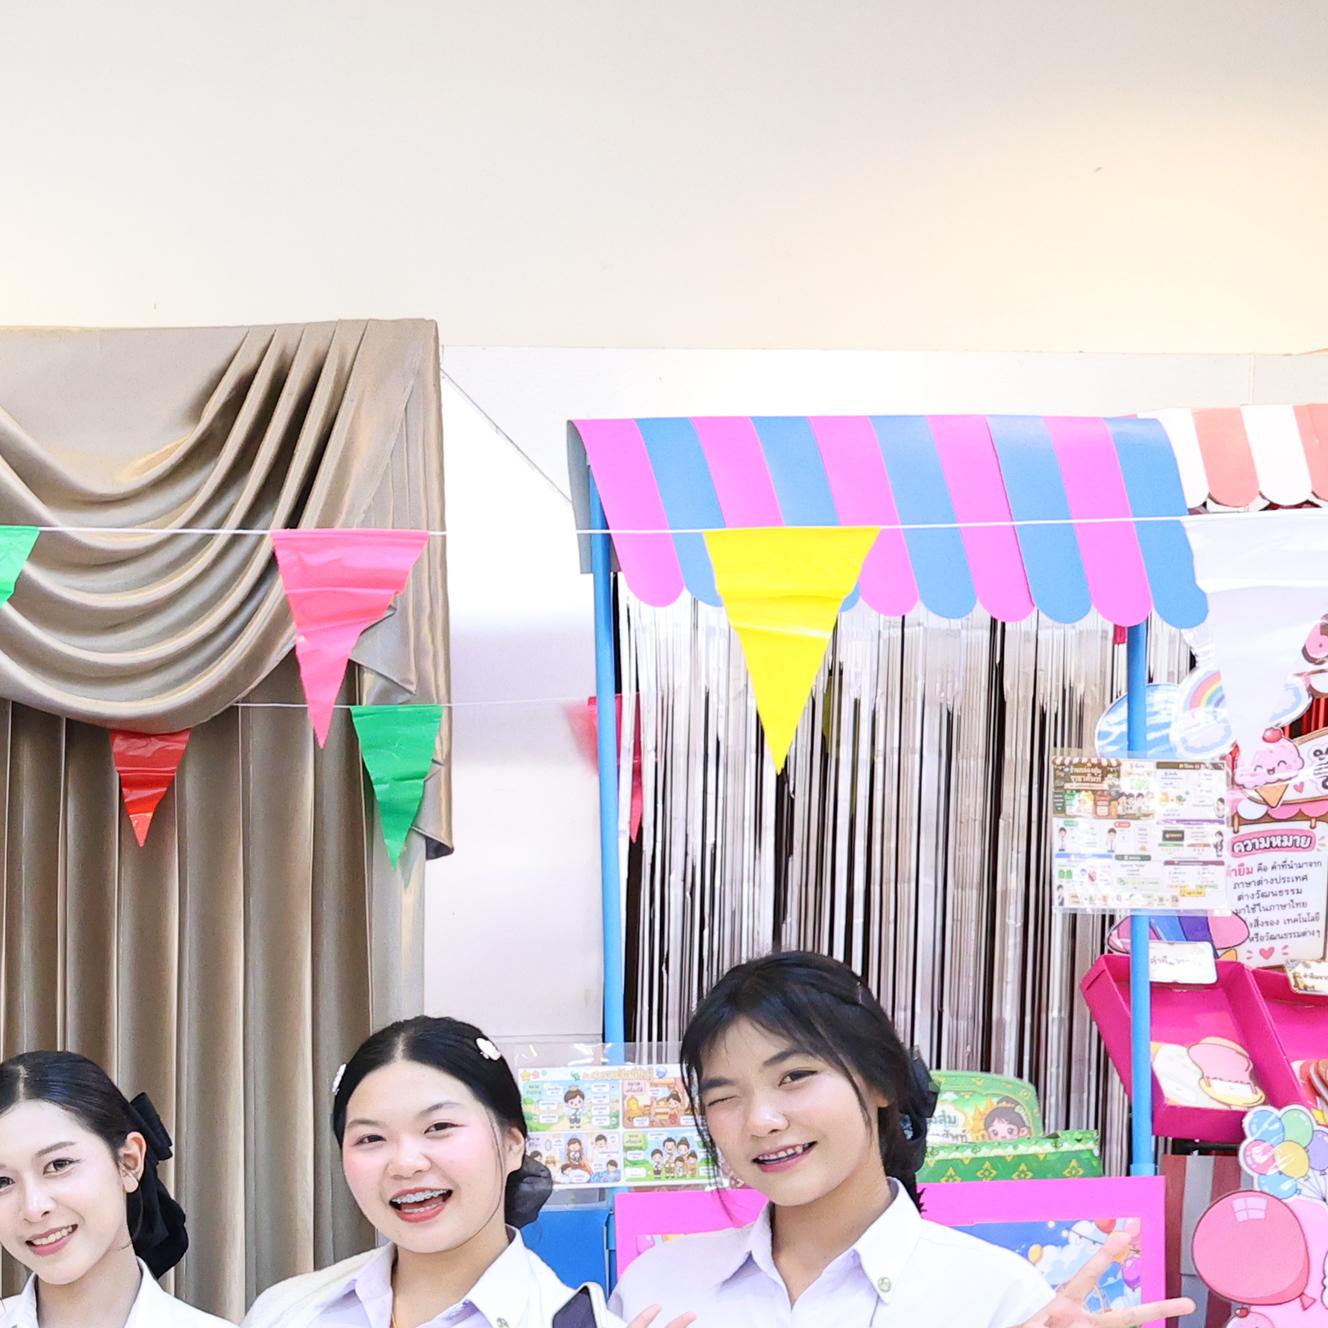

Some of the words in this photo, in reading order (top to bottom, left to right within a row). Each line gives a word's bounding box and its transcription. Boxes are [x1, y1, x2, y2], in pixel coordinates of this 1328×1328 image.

[1232, 834, 1312, 854] ความหมาย
[1227, 863, 1254, 878] ำยืม
[1257, 862, 1268, 873] คือ
[1271, 858, 1322, 871] คำที่นำมาจาก
[1233, 874, 1308, 889] ภาษาต่างประเทศ
[1237, 888, 1302, 901] ต่างวัฒนธรรม
[1284, 912, 1320, 924] เทคโนโลยี
